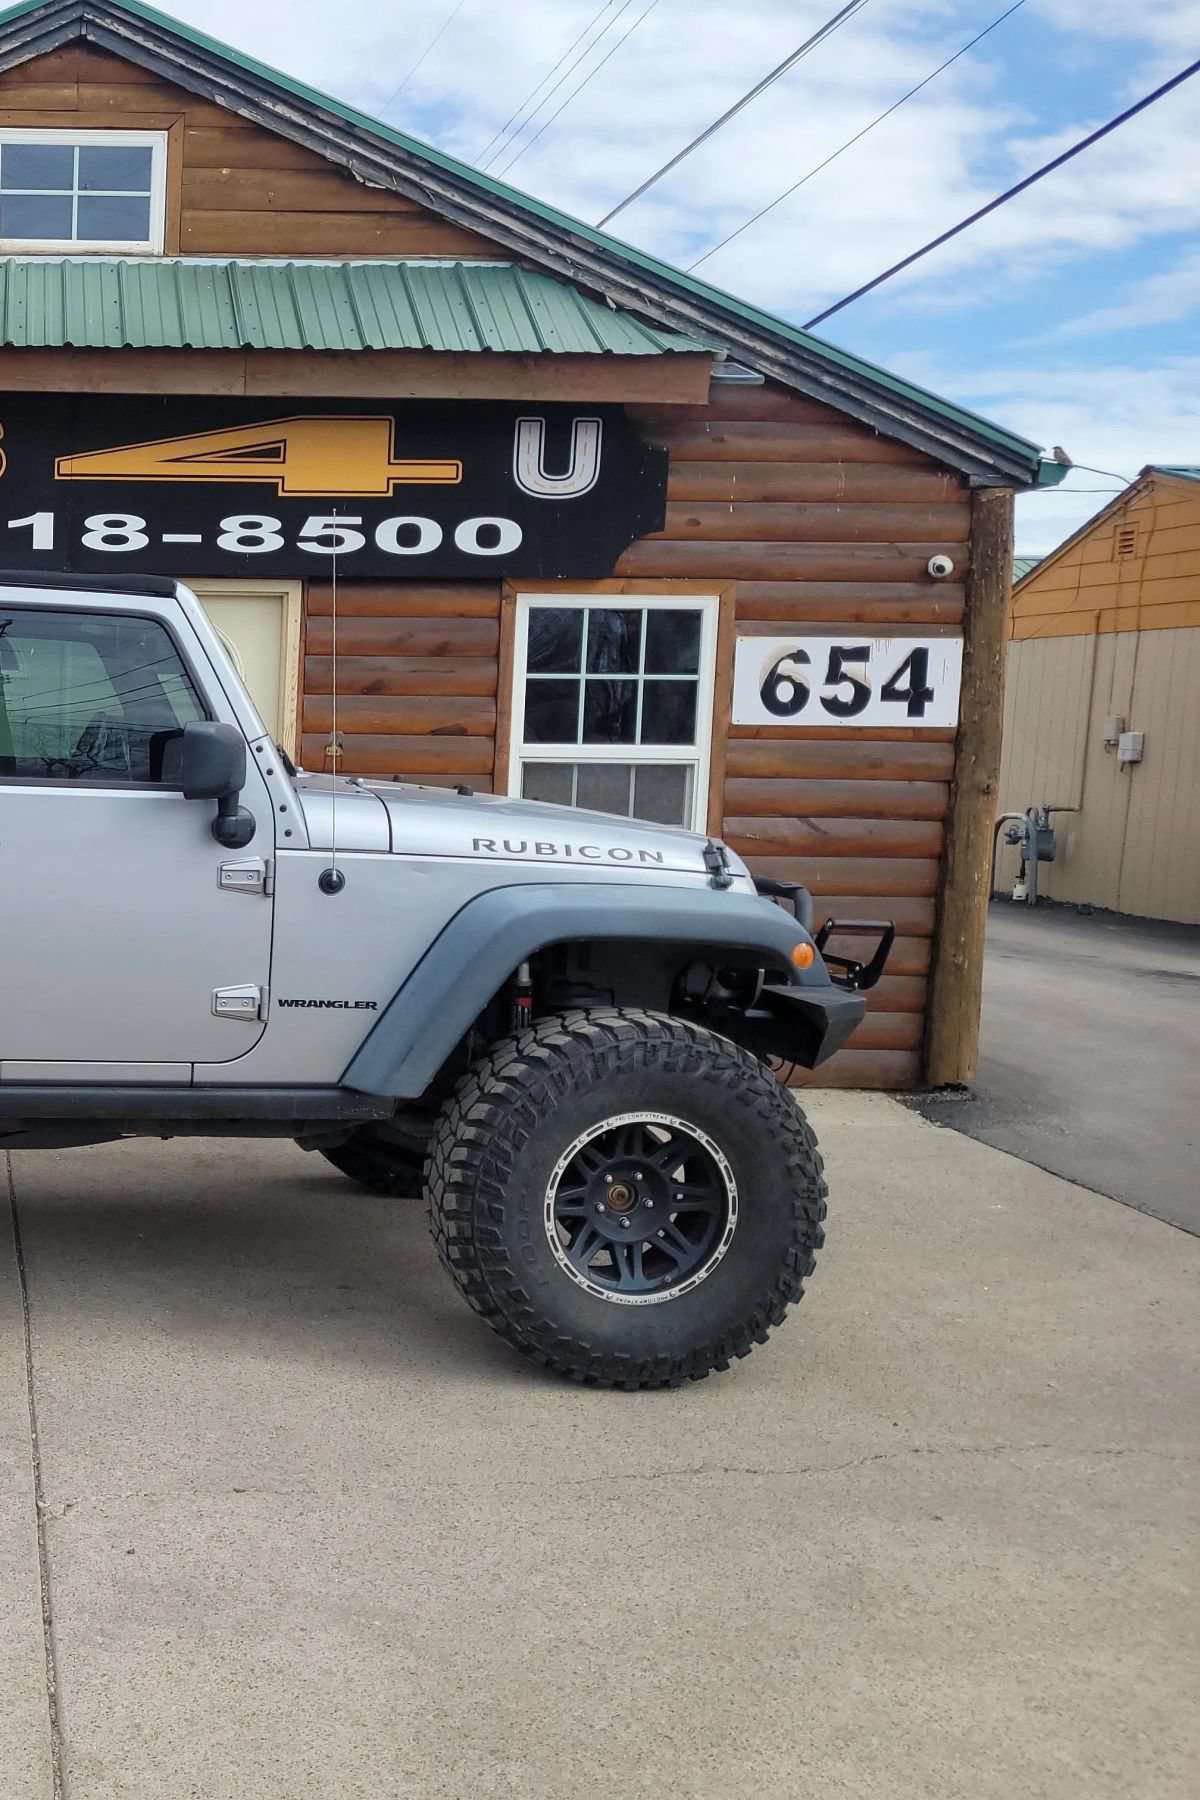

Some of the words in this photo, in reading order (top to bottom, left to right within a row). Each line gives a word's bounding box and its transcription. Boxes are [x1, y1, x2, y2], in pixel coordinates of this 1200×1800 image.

[54, 415, 463, 497] 4
[513, 416, 602, 499] U
[759, 644, 935, 718] 654
[472, 838, 664, 863] RUBICON
[278, 998, 379, 1010] WRANGLER
